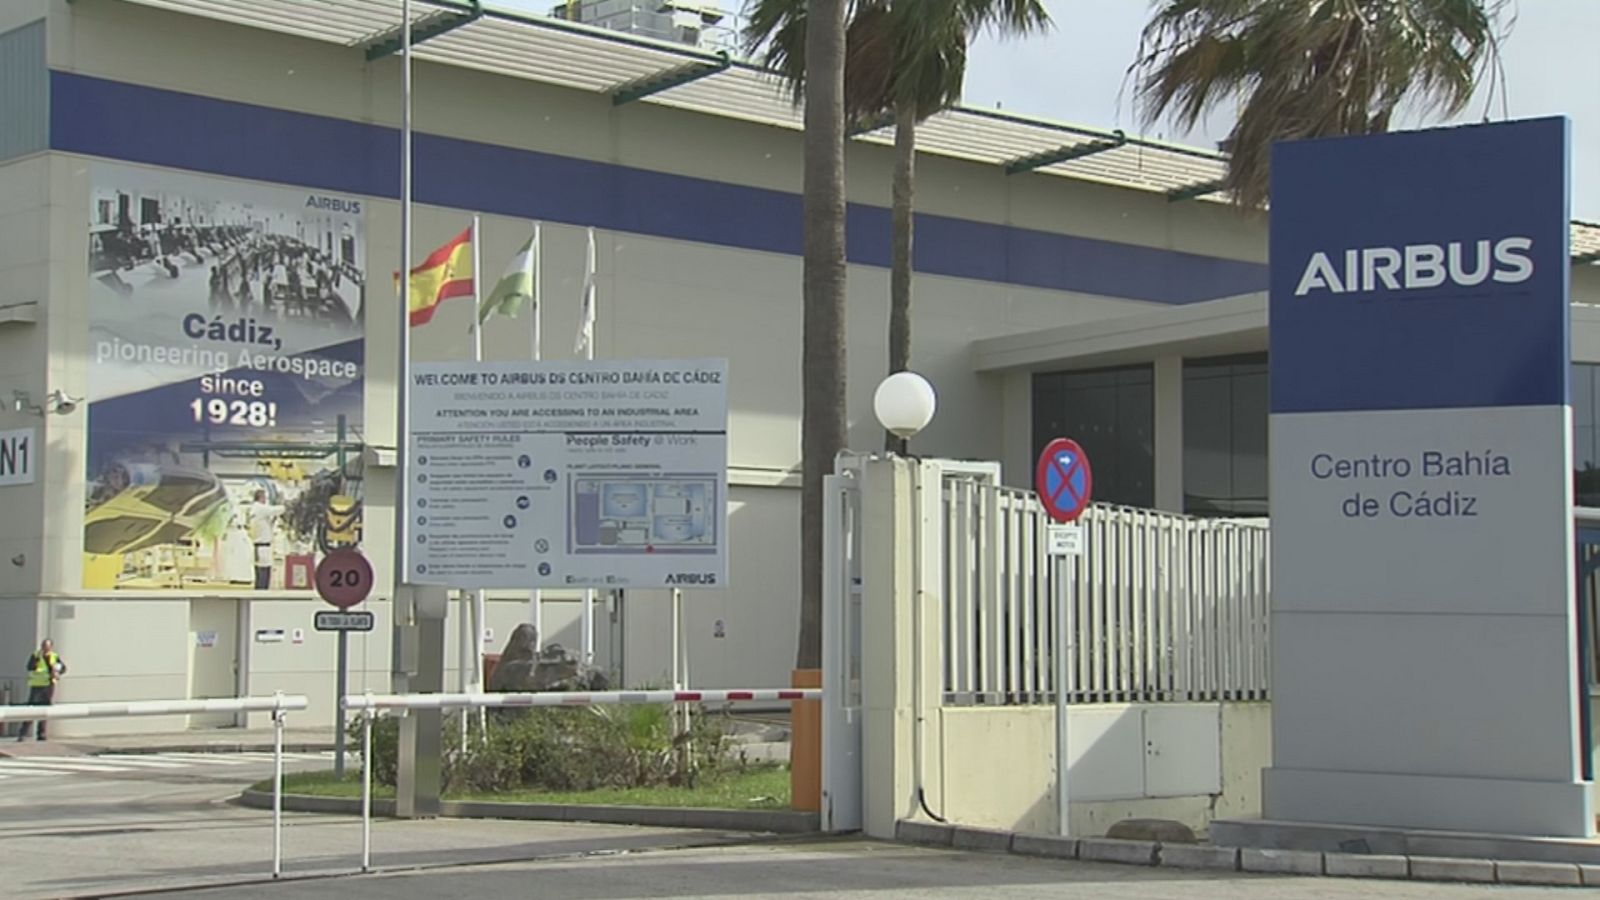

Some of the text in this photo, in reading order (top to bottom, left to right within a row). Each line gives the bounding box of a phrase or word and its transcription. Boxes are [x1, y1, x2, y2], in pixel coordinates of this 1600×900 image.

[305, 195, 361, 214] AIRBUS
[1294, 237, 1534, 296] AIRBUS
[183, 313, 282, 350] Cádiz,
[97, 338, 357, 379] pioneering Aerospace
[200, 373, 264, 396] since
[413, 368, 721, 386] WELCOME TO AIRBUS DS CENTRO BAHÍA DE CÁDIZ
[190, 398, 277, 426] 1928!
[436, 408, 699, 417] ATTENTION YOU ARE ACCESSING TO AN INDUSTRIAL AREA
[567, 435, 609, 447] People
[612, 435, 651, 447] Safety
[668, 435, 697, 445] Work
[1311, 449, 1511, 479] Centro Bahía
[1342, 491, 1478, 517] de Cádiz
[329, 569, 360, 587] 20
[664, 573, 716, 585] AIRBUS
